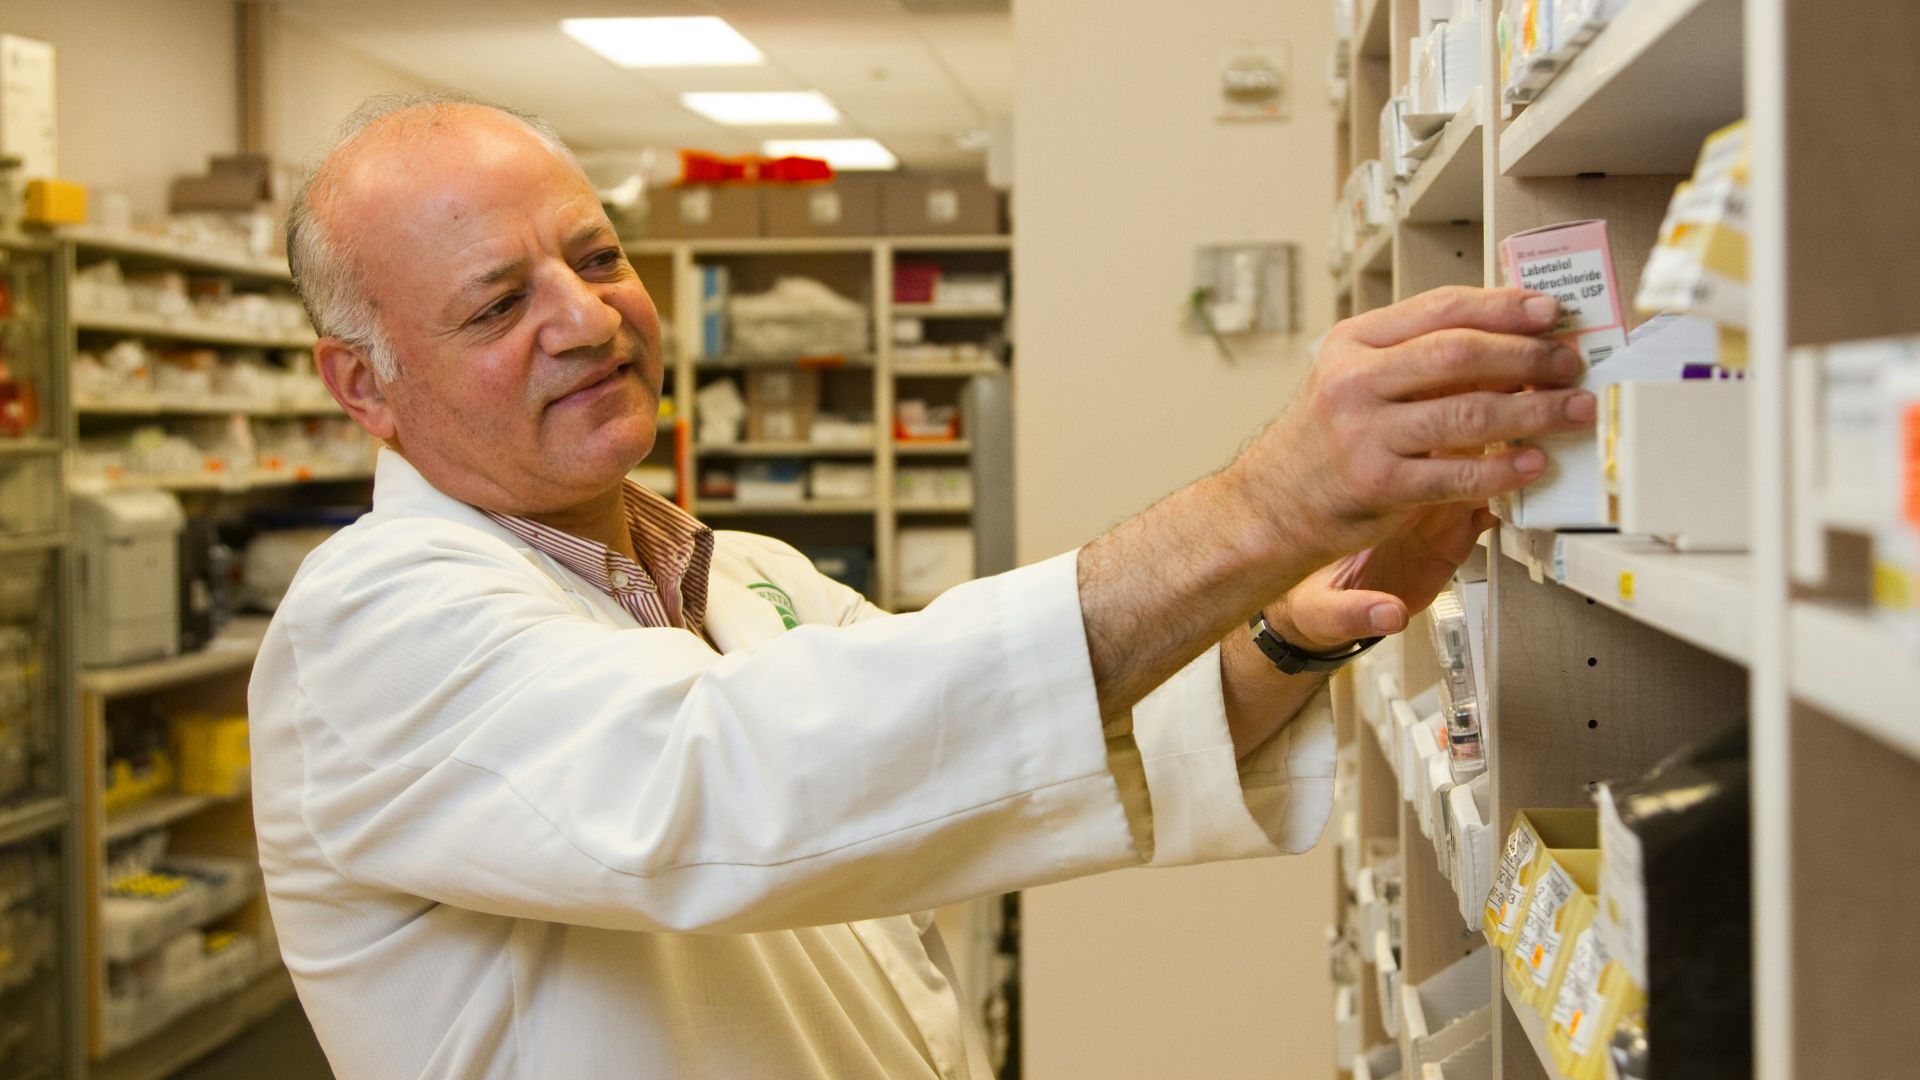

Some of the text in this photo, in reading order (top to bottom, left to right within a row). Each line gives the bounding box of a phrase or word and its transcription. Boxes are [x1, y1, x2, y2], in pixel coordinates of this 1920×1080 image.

[1521, 258, 1572, 278] Labetalol
[1524, 270, 1602, 290] Hydrochloride
[1581, 284, 1604, 298] USP
